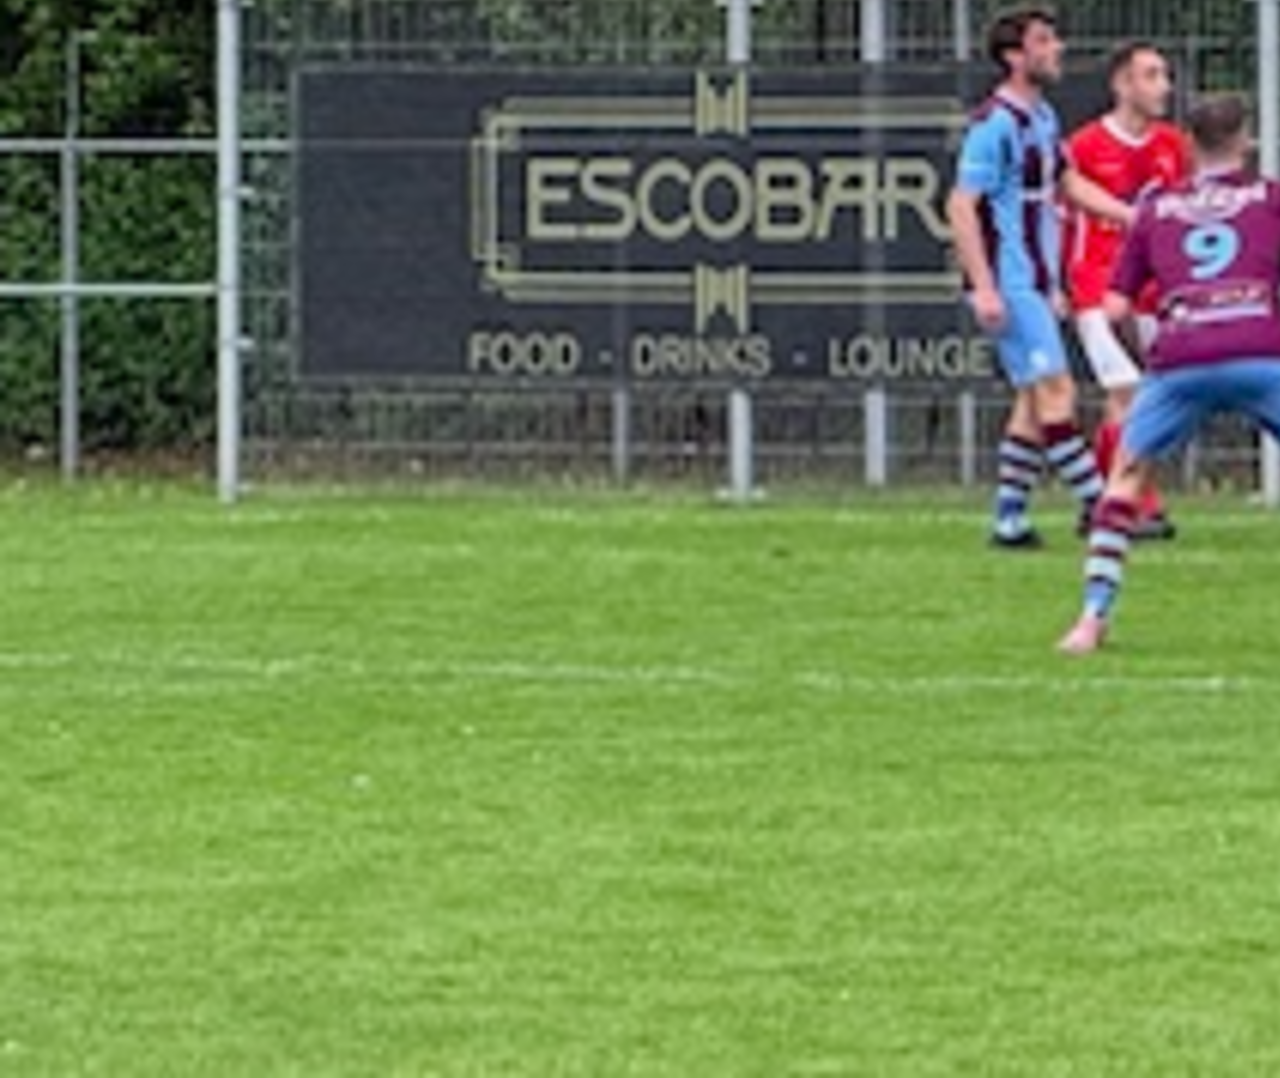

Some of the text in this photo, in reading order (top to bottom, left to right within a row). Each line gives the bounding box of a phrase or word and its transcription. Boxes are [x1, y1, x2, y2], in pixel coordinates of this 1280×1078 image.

[525, 158, 954, 241] ESCOBAR
[1183, 224, 1240, 280] 9
[468, 333, 582, 374] FOOD
[632, 335, 772, 377] DRINKS
[829, 337, 993, 377] LOUNGE
